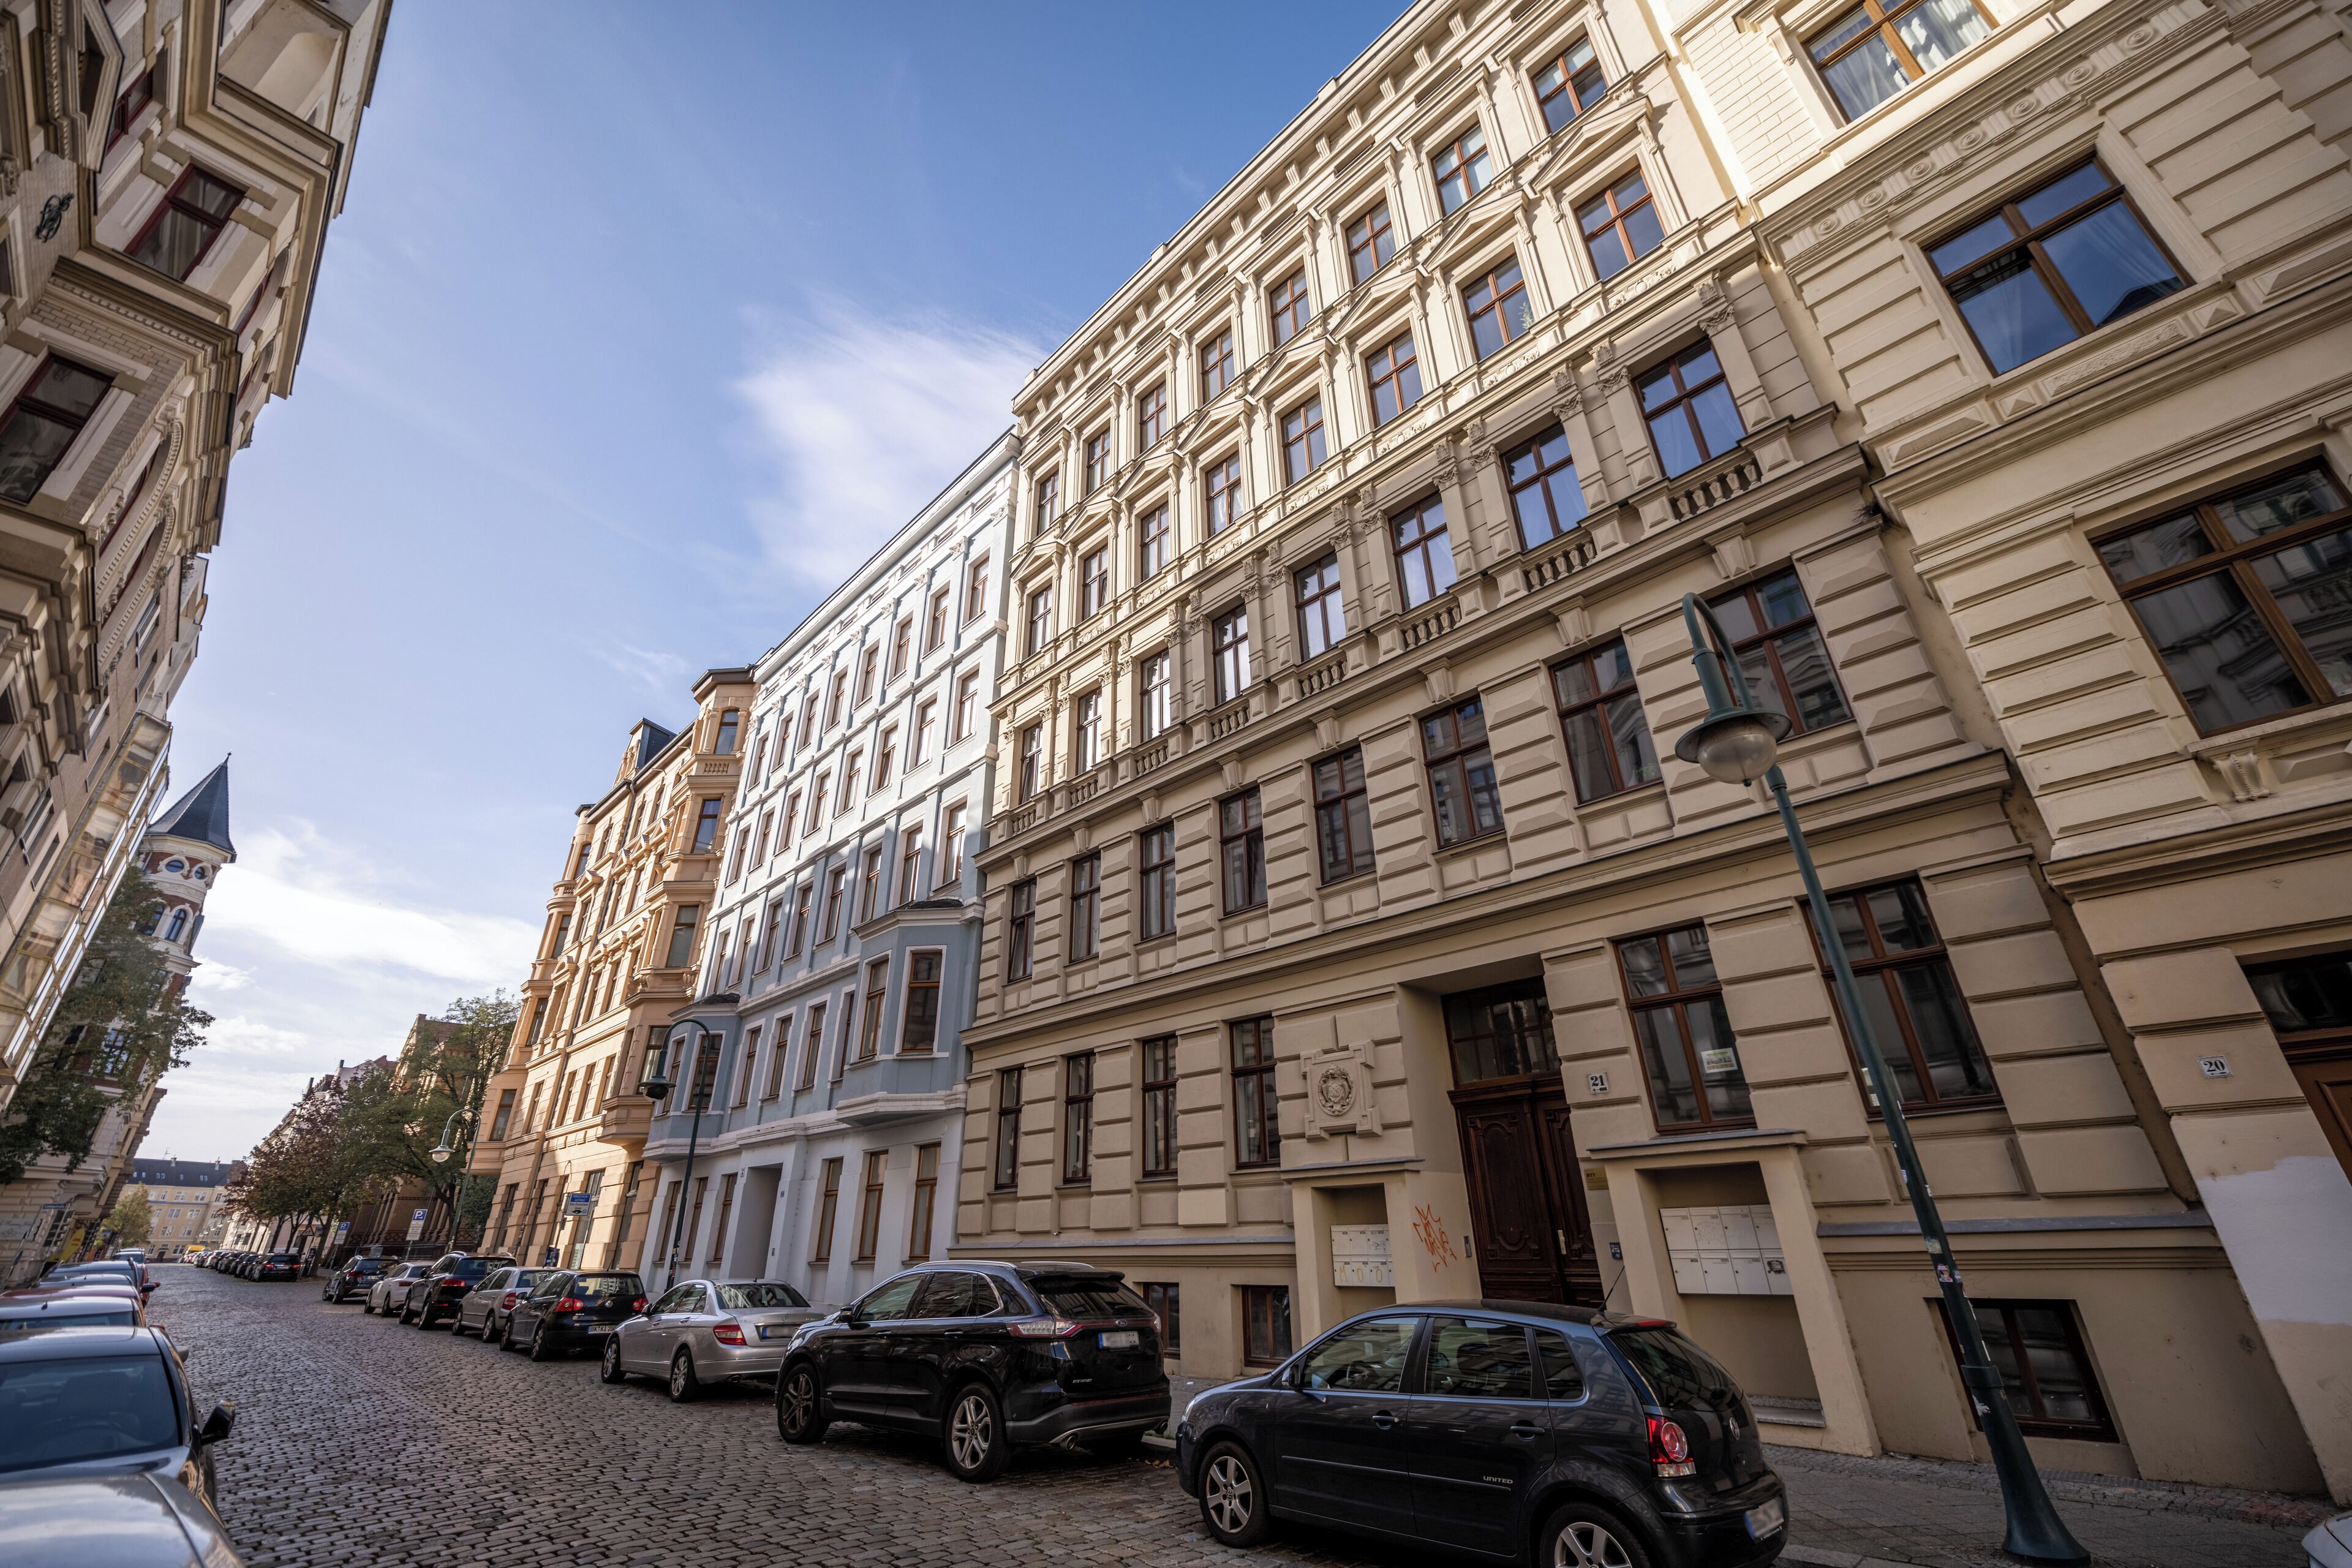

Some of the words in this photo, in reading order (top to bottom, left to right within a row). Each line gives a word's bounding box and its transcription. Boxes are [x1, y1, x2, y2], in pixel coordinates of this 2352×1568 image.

[2204, 1060, 2225, 1072] 20
[1590, 1075, 1605, 1087] 21
[415, 1211, 423, 1219] P
[1483, 1476, 1513, 1484] UNITED
